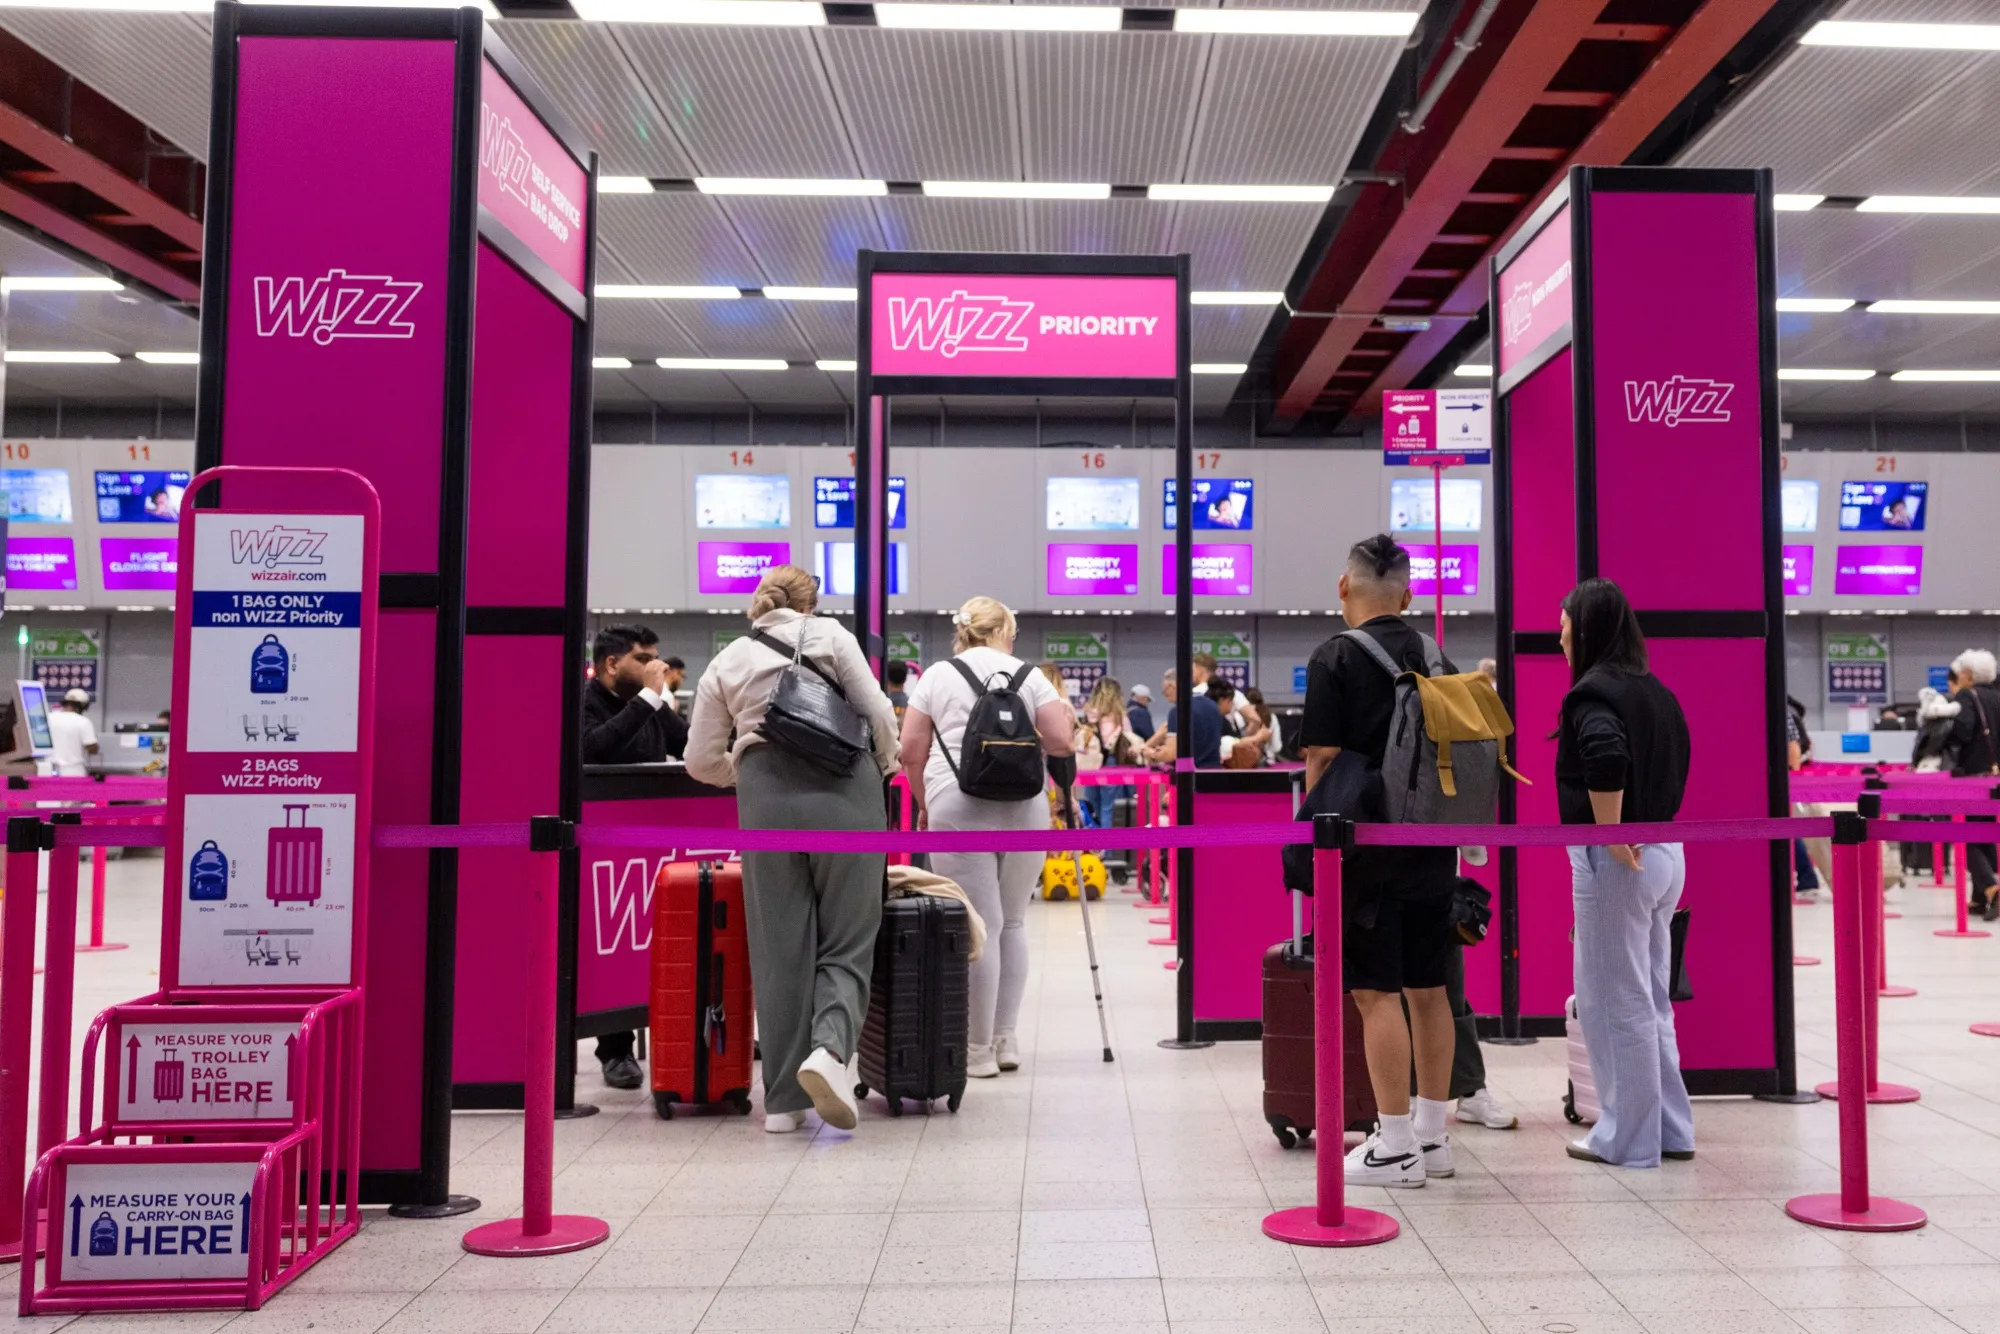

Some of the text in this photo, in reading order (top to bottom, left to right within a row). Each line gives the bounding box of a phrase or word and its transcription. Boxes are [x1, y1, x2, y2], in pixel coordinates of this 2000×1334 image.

[531, 163, 581, 229] SELF SERVICE
[530, 192, 569, 244] BAG DROP
[1039, 315, 1158, 336] PRIORITY
[1392, 394, 1425, 402] PRIORITY
[5, 443, 30, 460] 10
[128, 445, 150, 461] 11
[729, 450, 754, 467] 14
[1082, 453, 1105, 469] 16
[1197, 453, 1221, 470] 17
[1876, 456, 1896, 472] 21
[817, 479, 839, 491] Sign
[717, 555, 772, 567] PRIORITY
[1066, 556, 1121, 568] PRIORITY
[251, 570, 327, 581] wizzair.com
[1065, 567, 1121, 579] CHECK-IN
[232, 595, 324, 608] 1 BAG ONLY
[212, 611, 343, 625] non WIZZ Priority
[242, 759, 299, 772] 2 BAGS
[222, 774, 322, 789] WIZZ Priority
[155, 1034, 272, 1046] MEASURE YOUR
[192, 1051, 270, 1064] TROLLEY
[191, 1067, 228, 1080] BAG
[191, 1081, 273, 1103] HERE
[90, 1193, 235, 1208] MEASURE YOUR
[127, 1210, 234, 1222] CARRY-ON BAG
[124, 1224, 233, 1256] HERE
